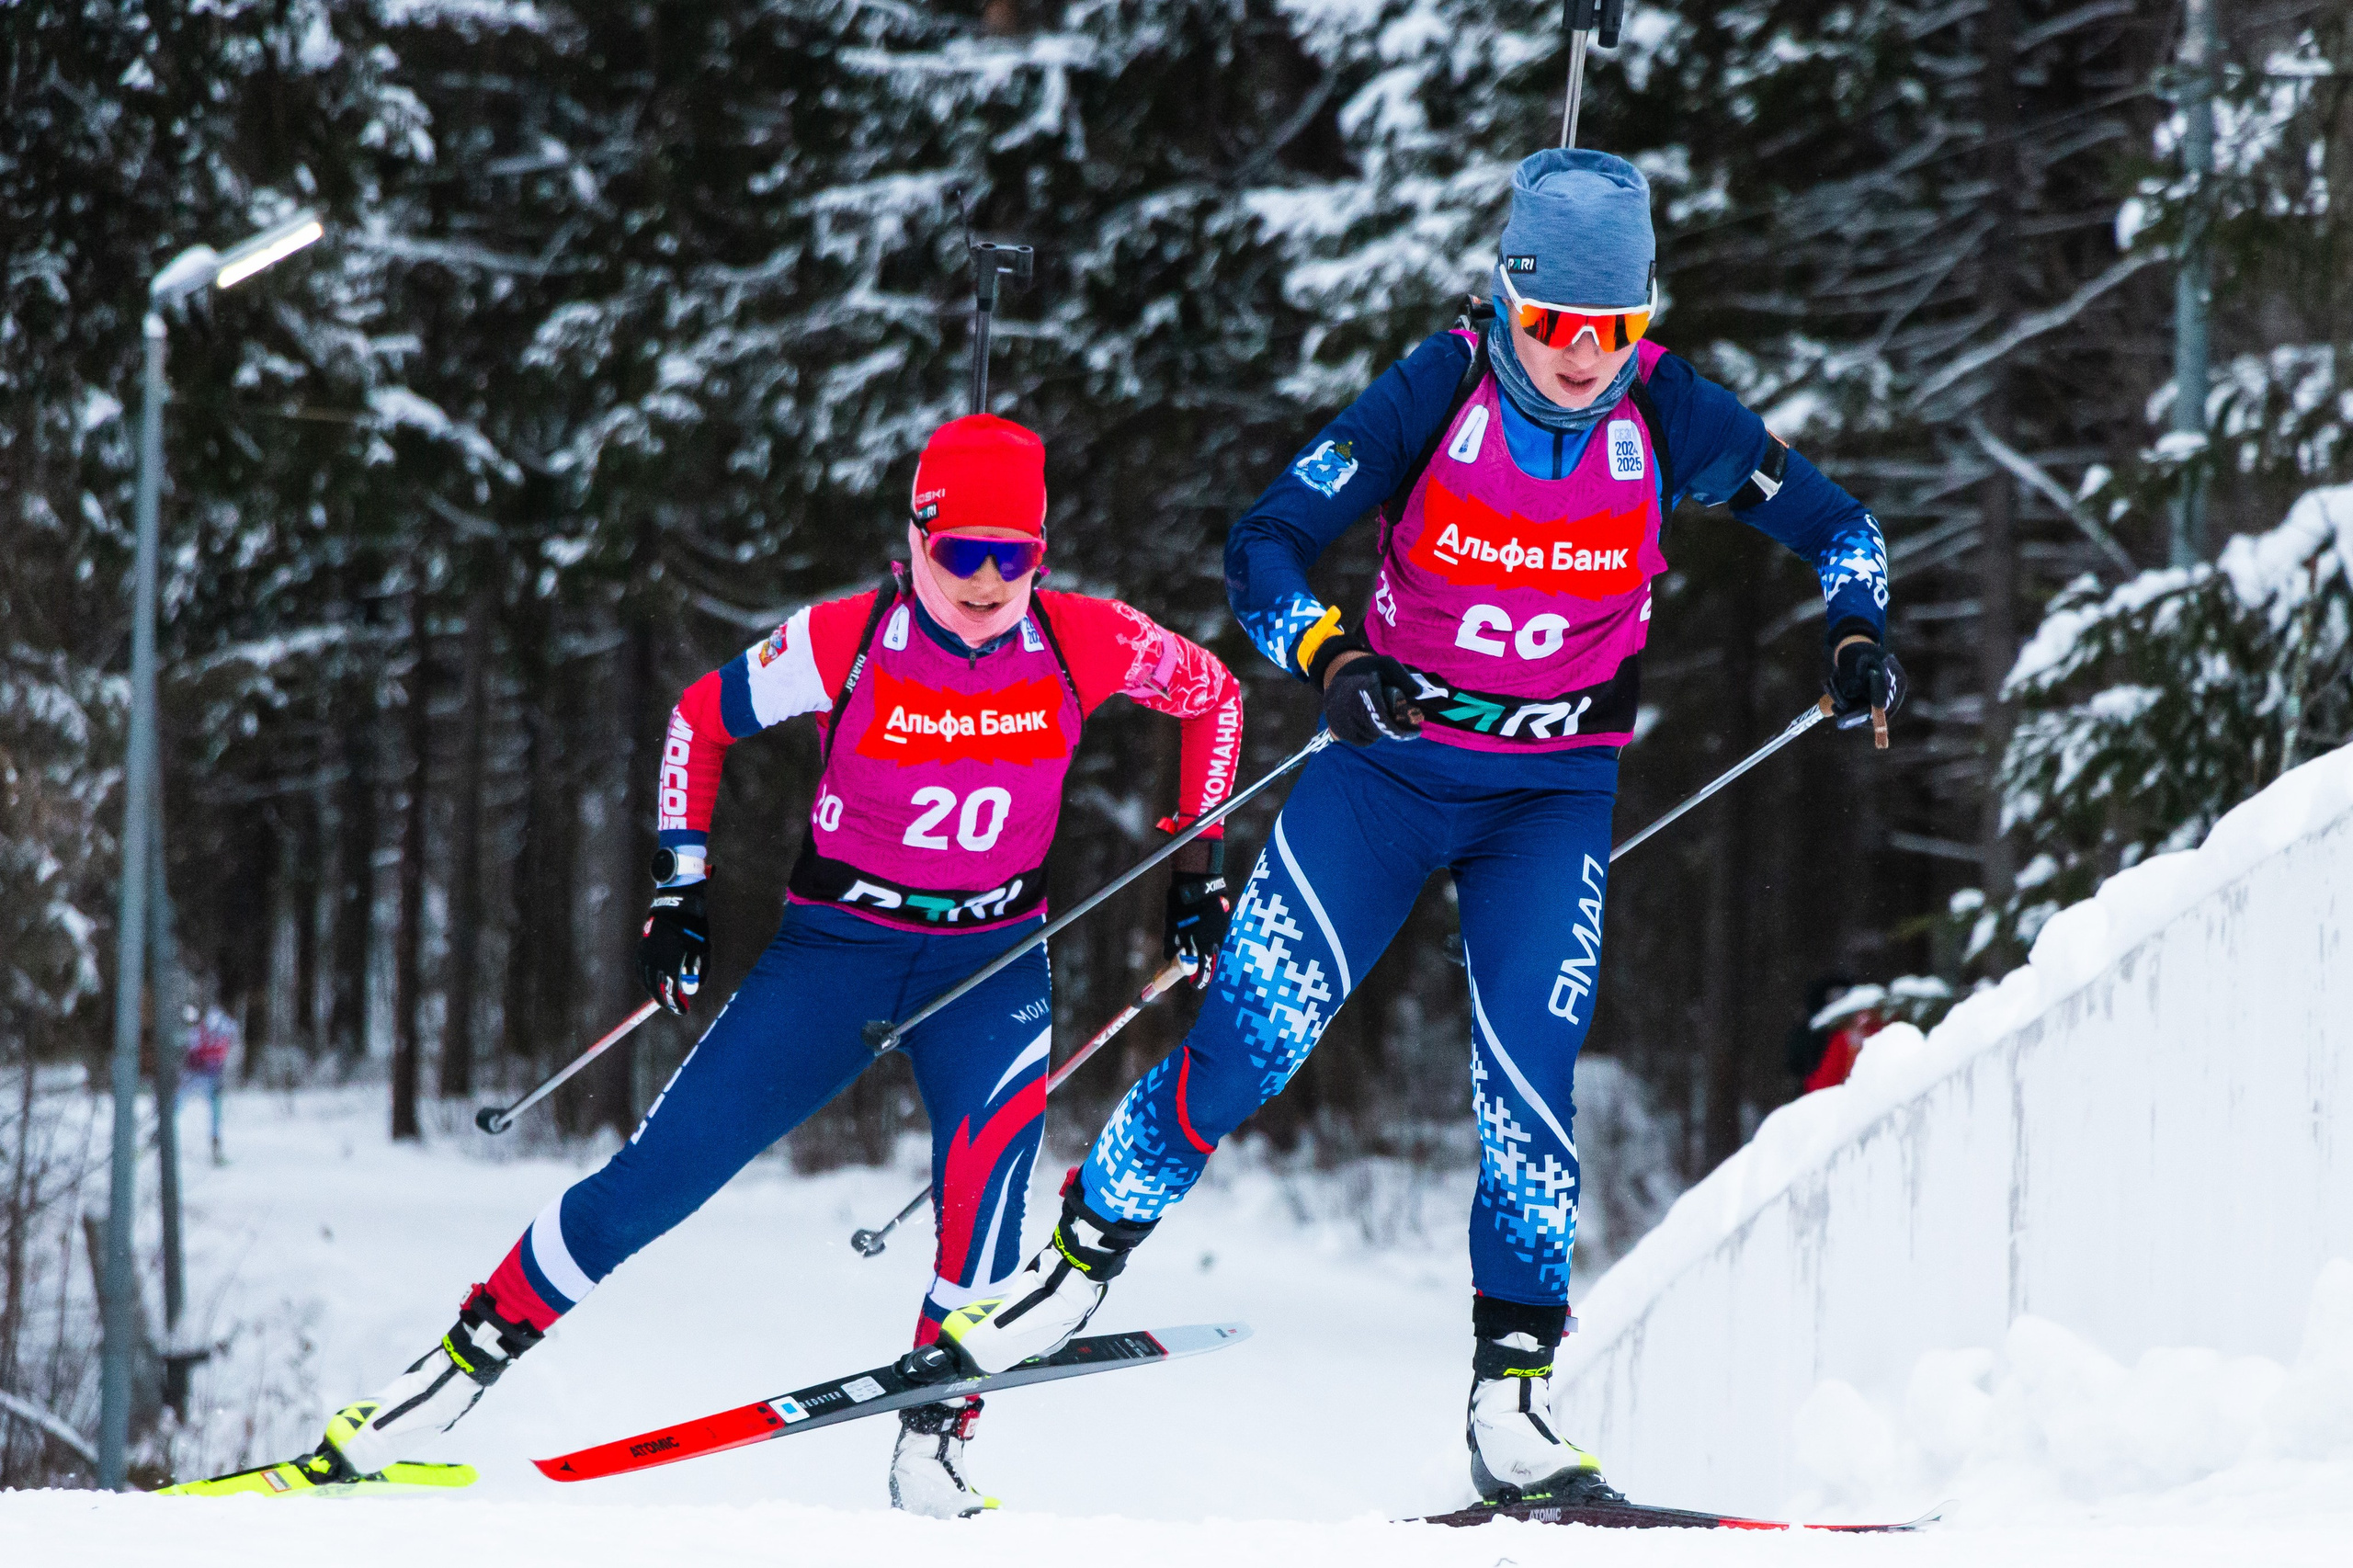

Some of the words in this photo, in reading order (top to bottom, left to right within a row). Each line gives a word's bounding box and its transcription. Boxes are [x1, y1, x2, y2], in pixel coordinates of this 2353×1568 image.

[1617, 457, 1643, 472] 2025
[1433, 523, 1544, 574] Альфа
[1552, 540, 1630, 572] Банк
[883, 705, 976, 745] Альфа
[981, 709, 1048, 735] Банк
[1199, 696, 1239, 817] КОМАНДА
[902, 786, 1012, 852] 20
[1548, 853, 1604, 1026] ЯМАЛ
[1503, 1363, 1553, 1377] FISCH
[629, 1436, 680, 1459] ATOMIC
[1529, 1507, 1562, 1522] ATOMIC
